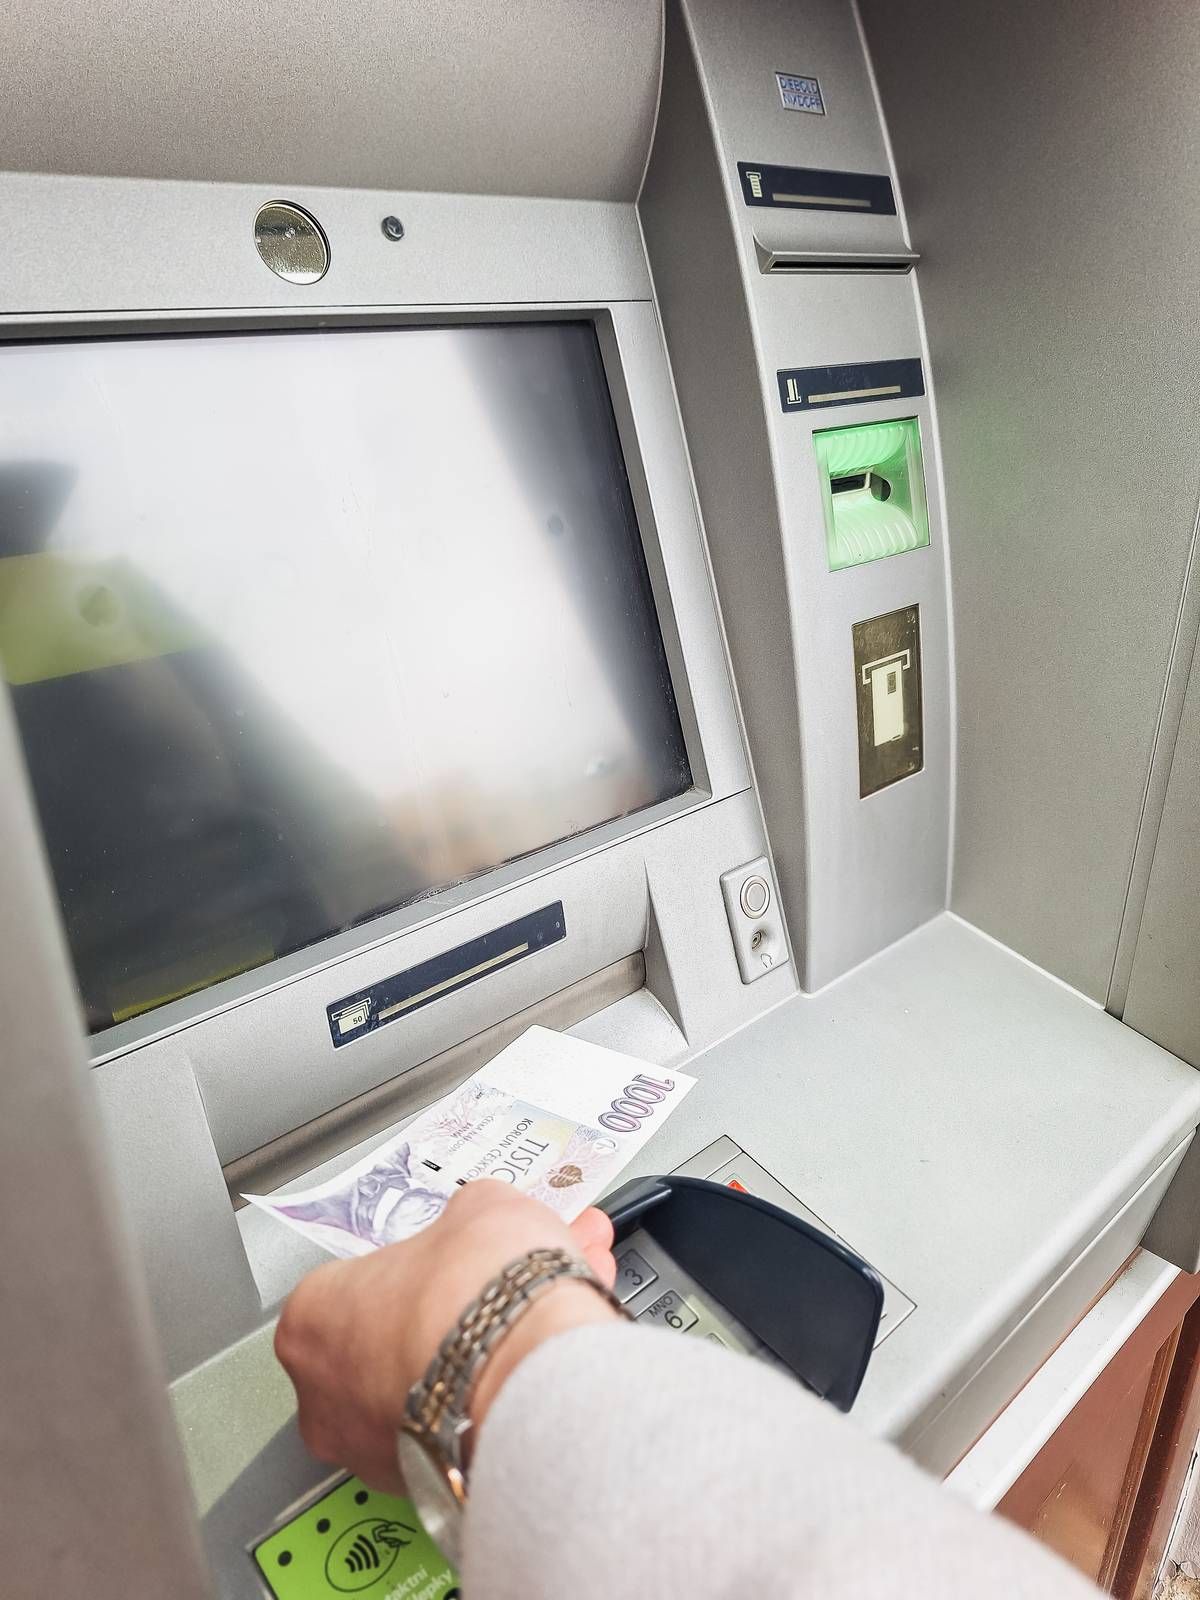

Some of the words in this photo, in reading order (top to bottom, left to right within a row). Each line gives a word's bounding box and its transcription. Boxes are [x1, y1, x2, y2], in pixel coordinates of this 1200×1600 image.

[779, 77, 818, 94] DIEBOLD
[352, 1015, 363, 1025] 50
[598, 1073, 675, 1132] 1000
[499, 1117, 533, 1148] KORUN
[490, 1138, 549, 1184] TISÍC
[625, 1268, 643, 1286] 3
[648, 1295, 674, 1317] MNO
[664, 1310, 683, 1329] 6
